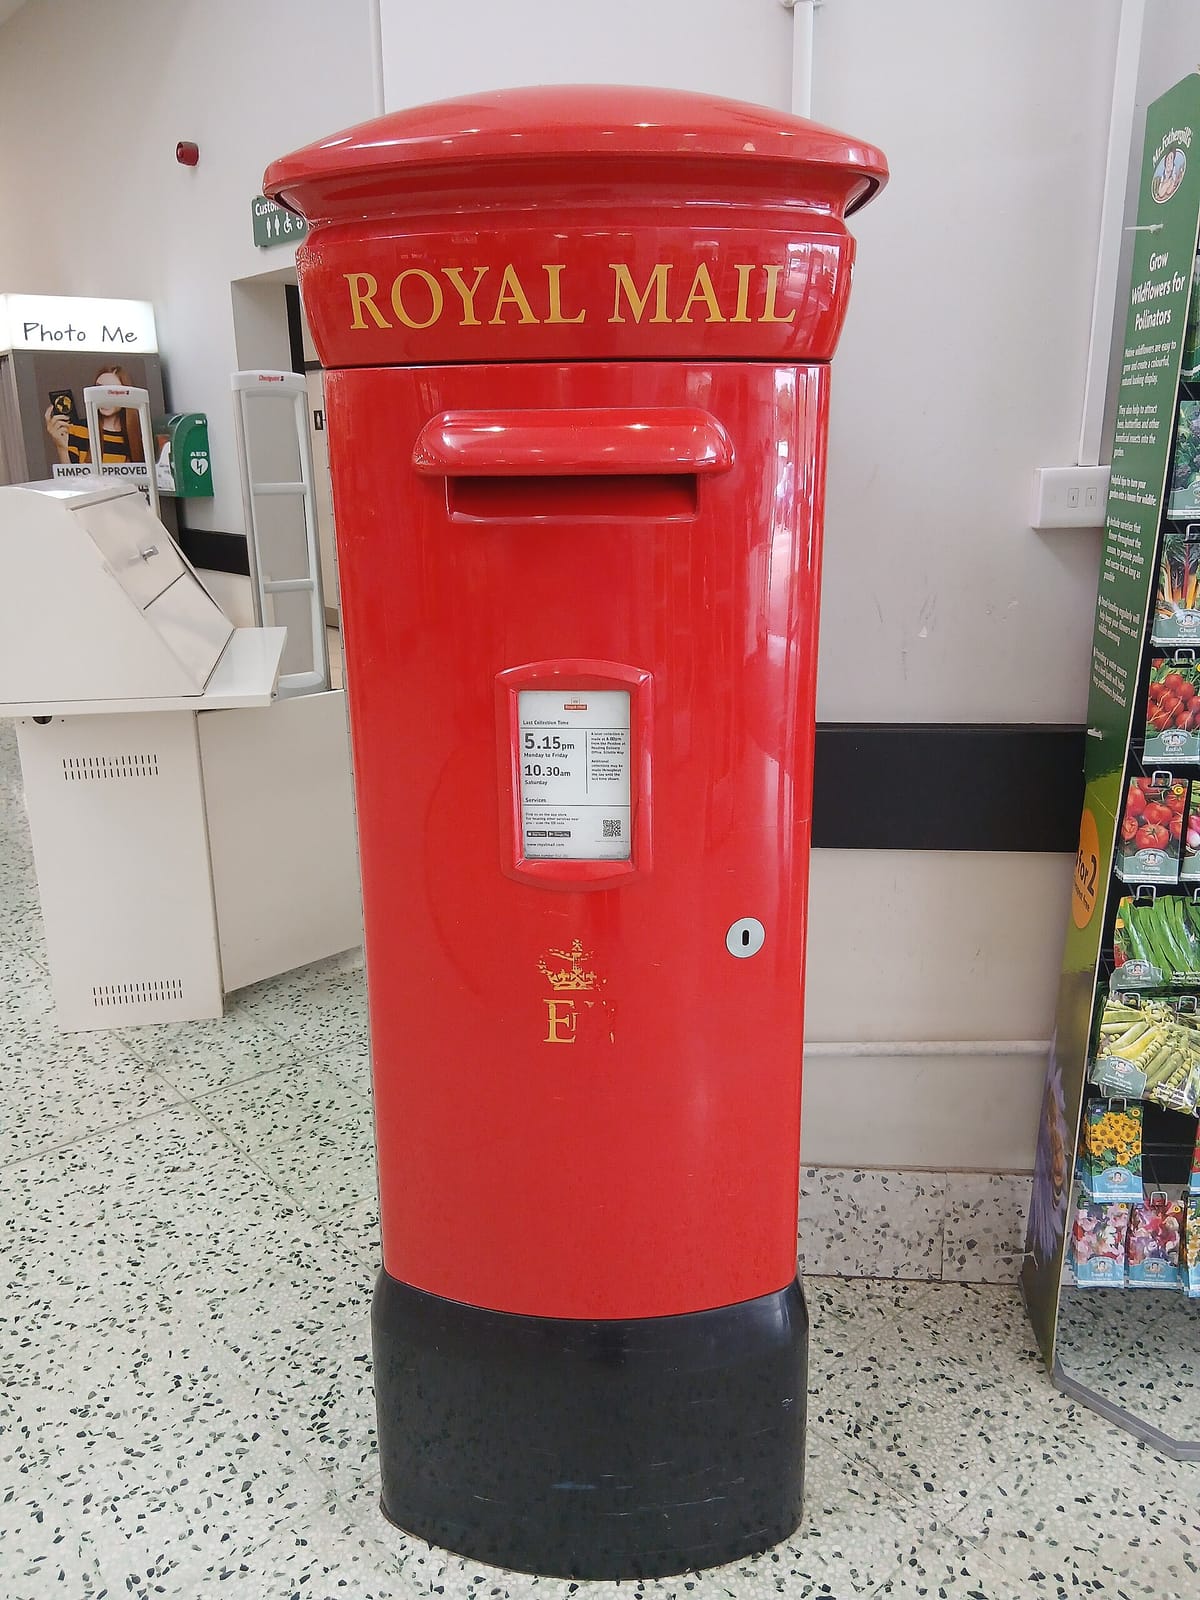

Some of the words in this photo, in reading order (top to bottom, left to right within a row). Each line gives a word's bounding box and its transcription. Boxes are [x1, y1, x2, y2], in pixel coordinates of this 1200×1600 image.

[1150, 252, 1168, 272] Grow
[342, 263, 586, 330] ROYAL
[607, 262, 796, 325] MAIL
[1132, 280, 1171, 305] Wildflowers
[1172, 272, 1186, 292] for
[1134, 309, 1172, 332] Pollinators
[23, 322, 86, 342] Photo
[102, 326, 138, 344] Me
[1161, 343, 1170, 353] easy
[1171, 340, 1176, 349] to
[57, 468, 91, 476] HMPO
[102, 466, 148, 475] PPROVED
[524, 733, 575, 751] 5.15pm
[524, 764, 570, 776] 10.30am
[1087, 854, 1097, 896] 2
